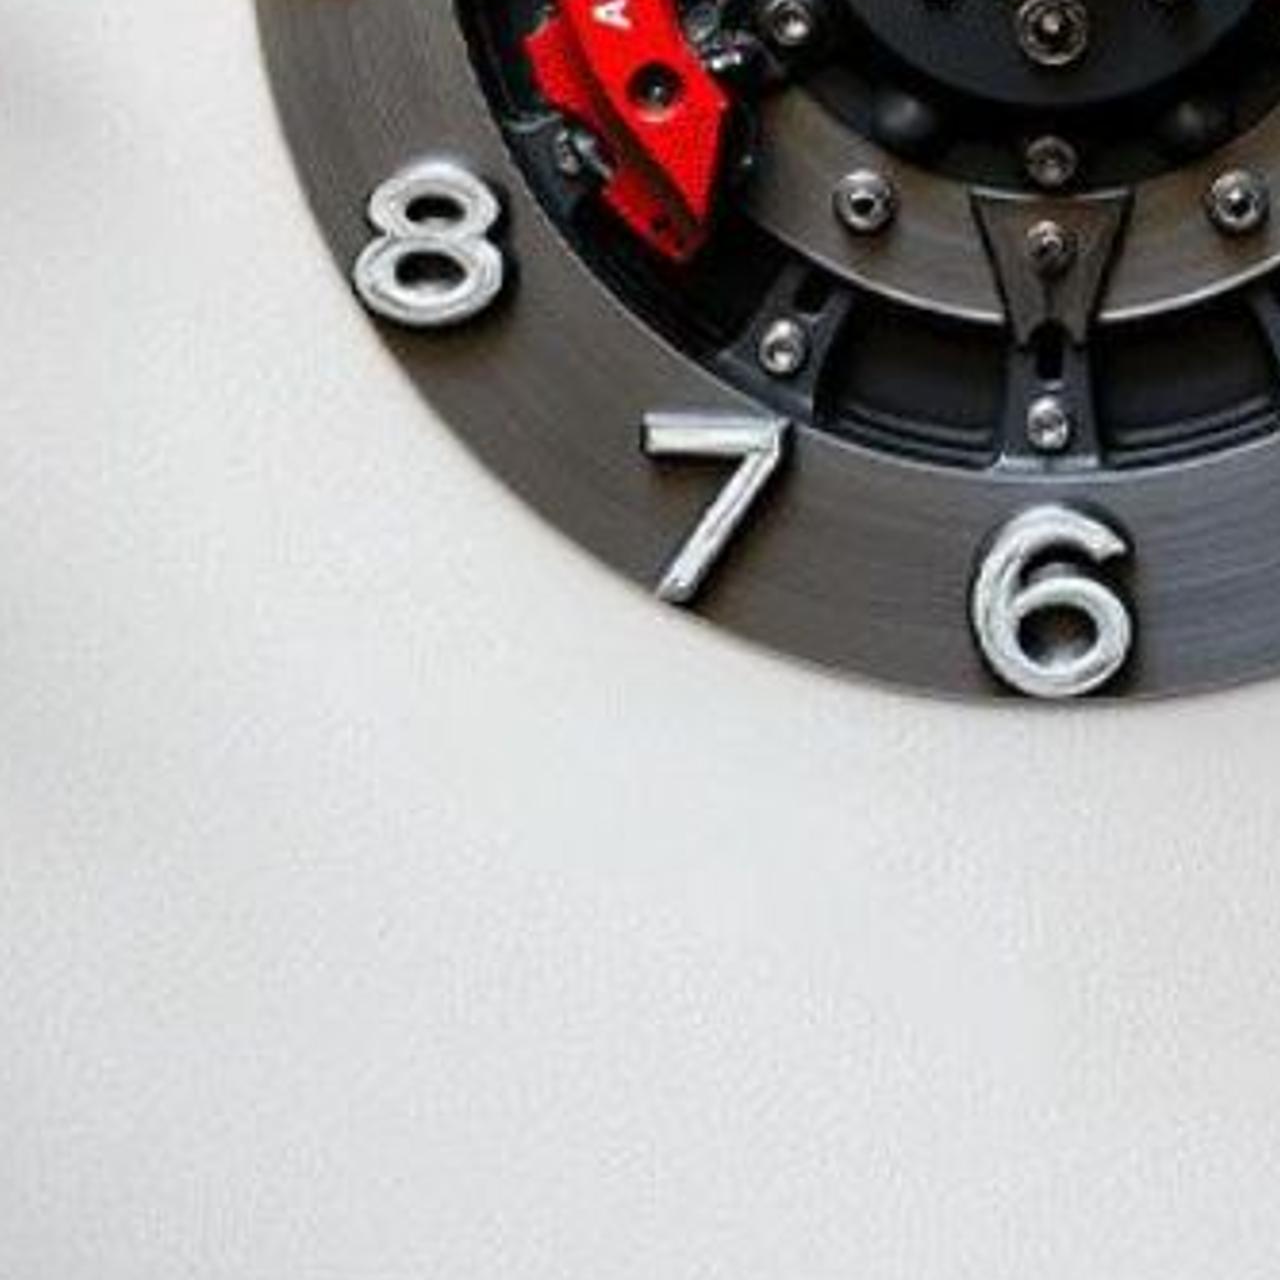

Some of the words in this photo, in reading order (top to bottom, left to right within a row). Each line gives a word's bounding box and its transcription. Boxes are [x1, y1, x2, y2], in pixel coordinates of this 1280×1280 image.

[353, 162, 506, 326] 8
[640, 413, 790, 605] 7
[972, 503, 1135, 697] 6
